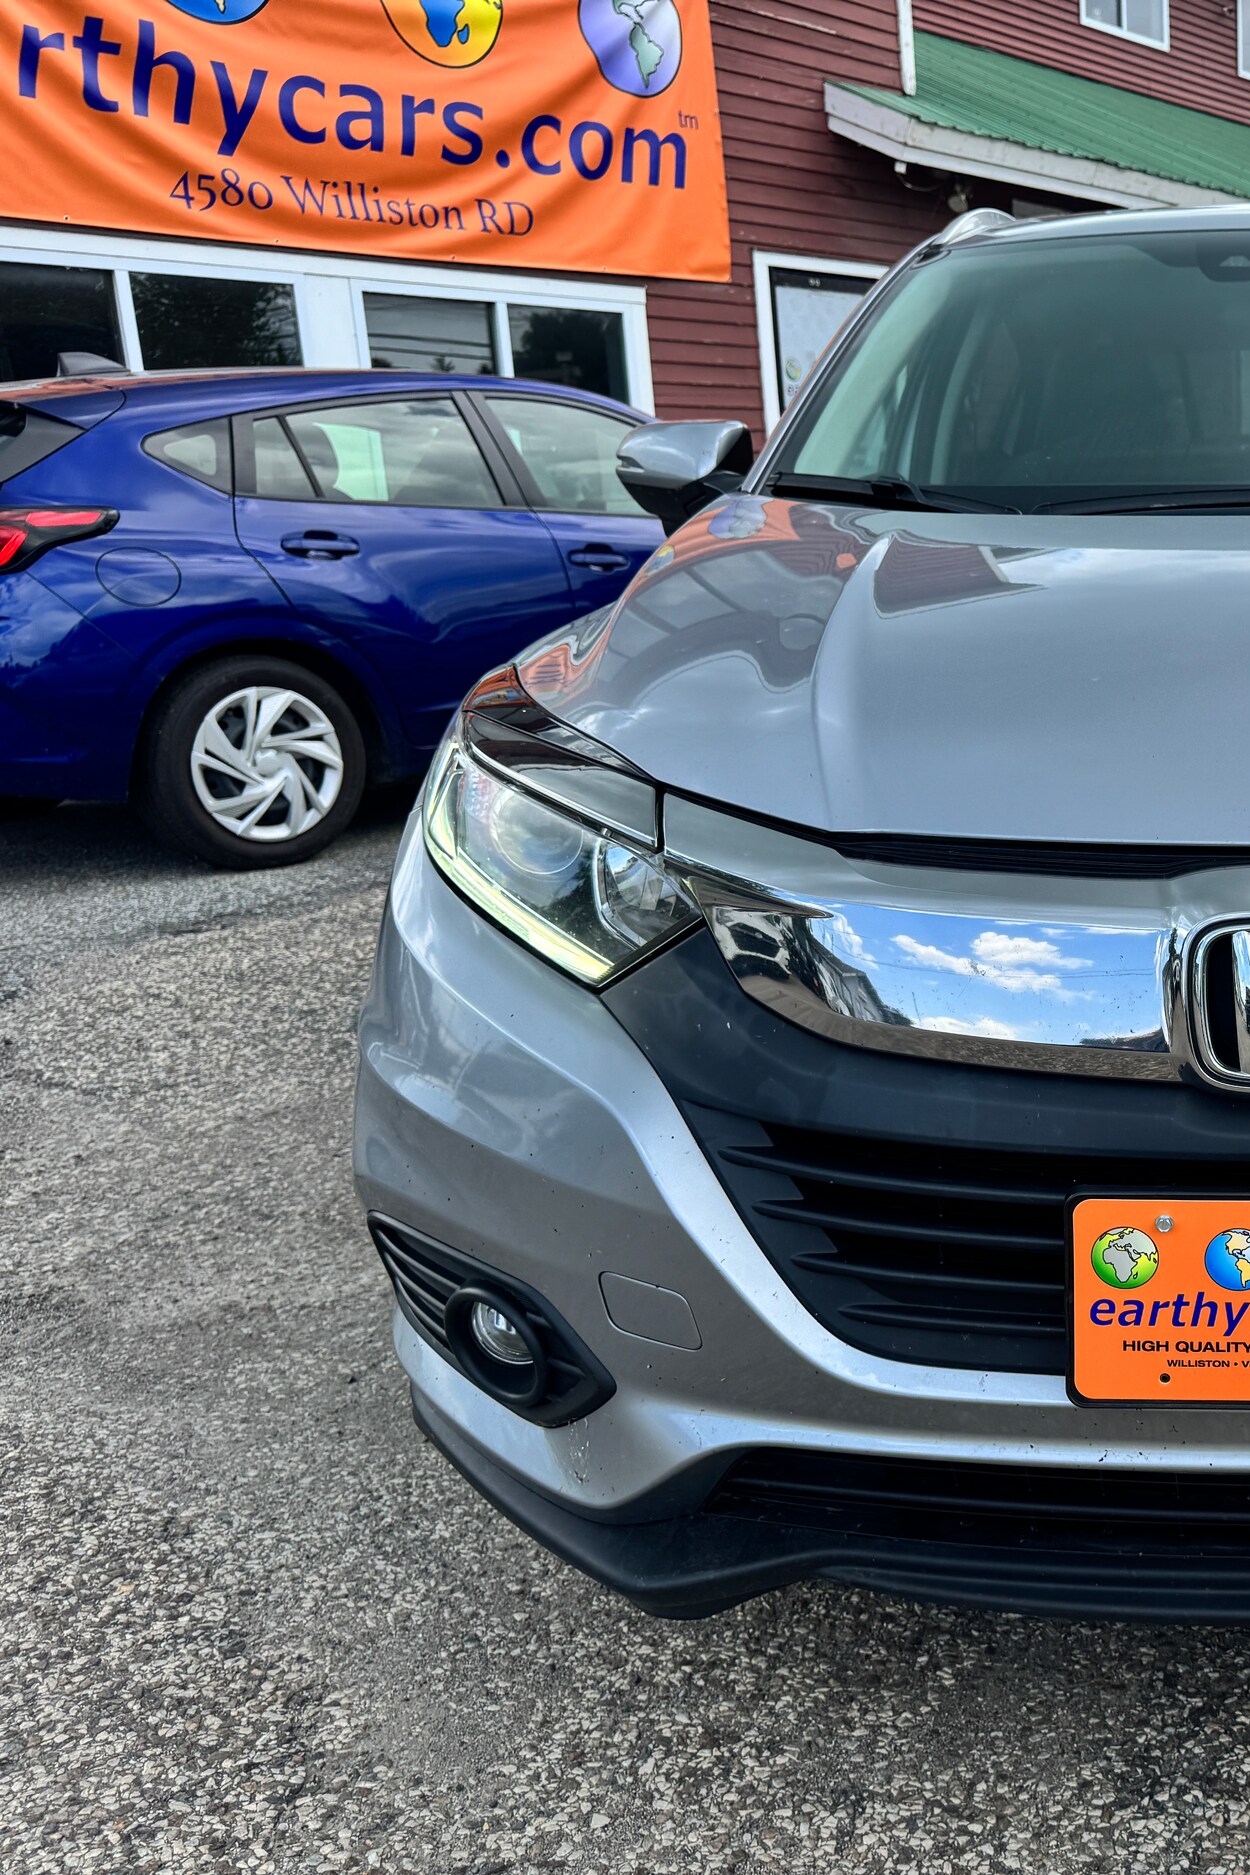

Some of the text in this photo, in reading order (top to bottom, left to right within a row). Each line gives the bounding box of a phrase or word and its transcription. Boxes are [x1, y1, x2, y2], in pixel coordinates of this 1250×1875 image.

[170, 168, 534, 236] 4580 Williston RD
[1122, 1340, 1169, 1352] HIGH
[1167, 1359, 1230, 1368] WILLISTON
